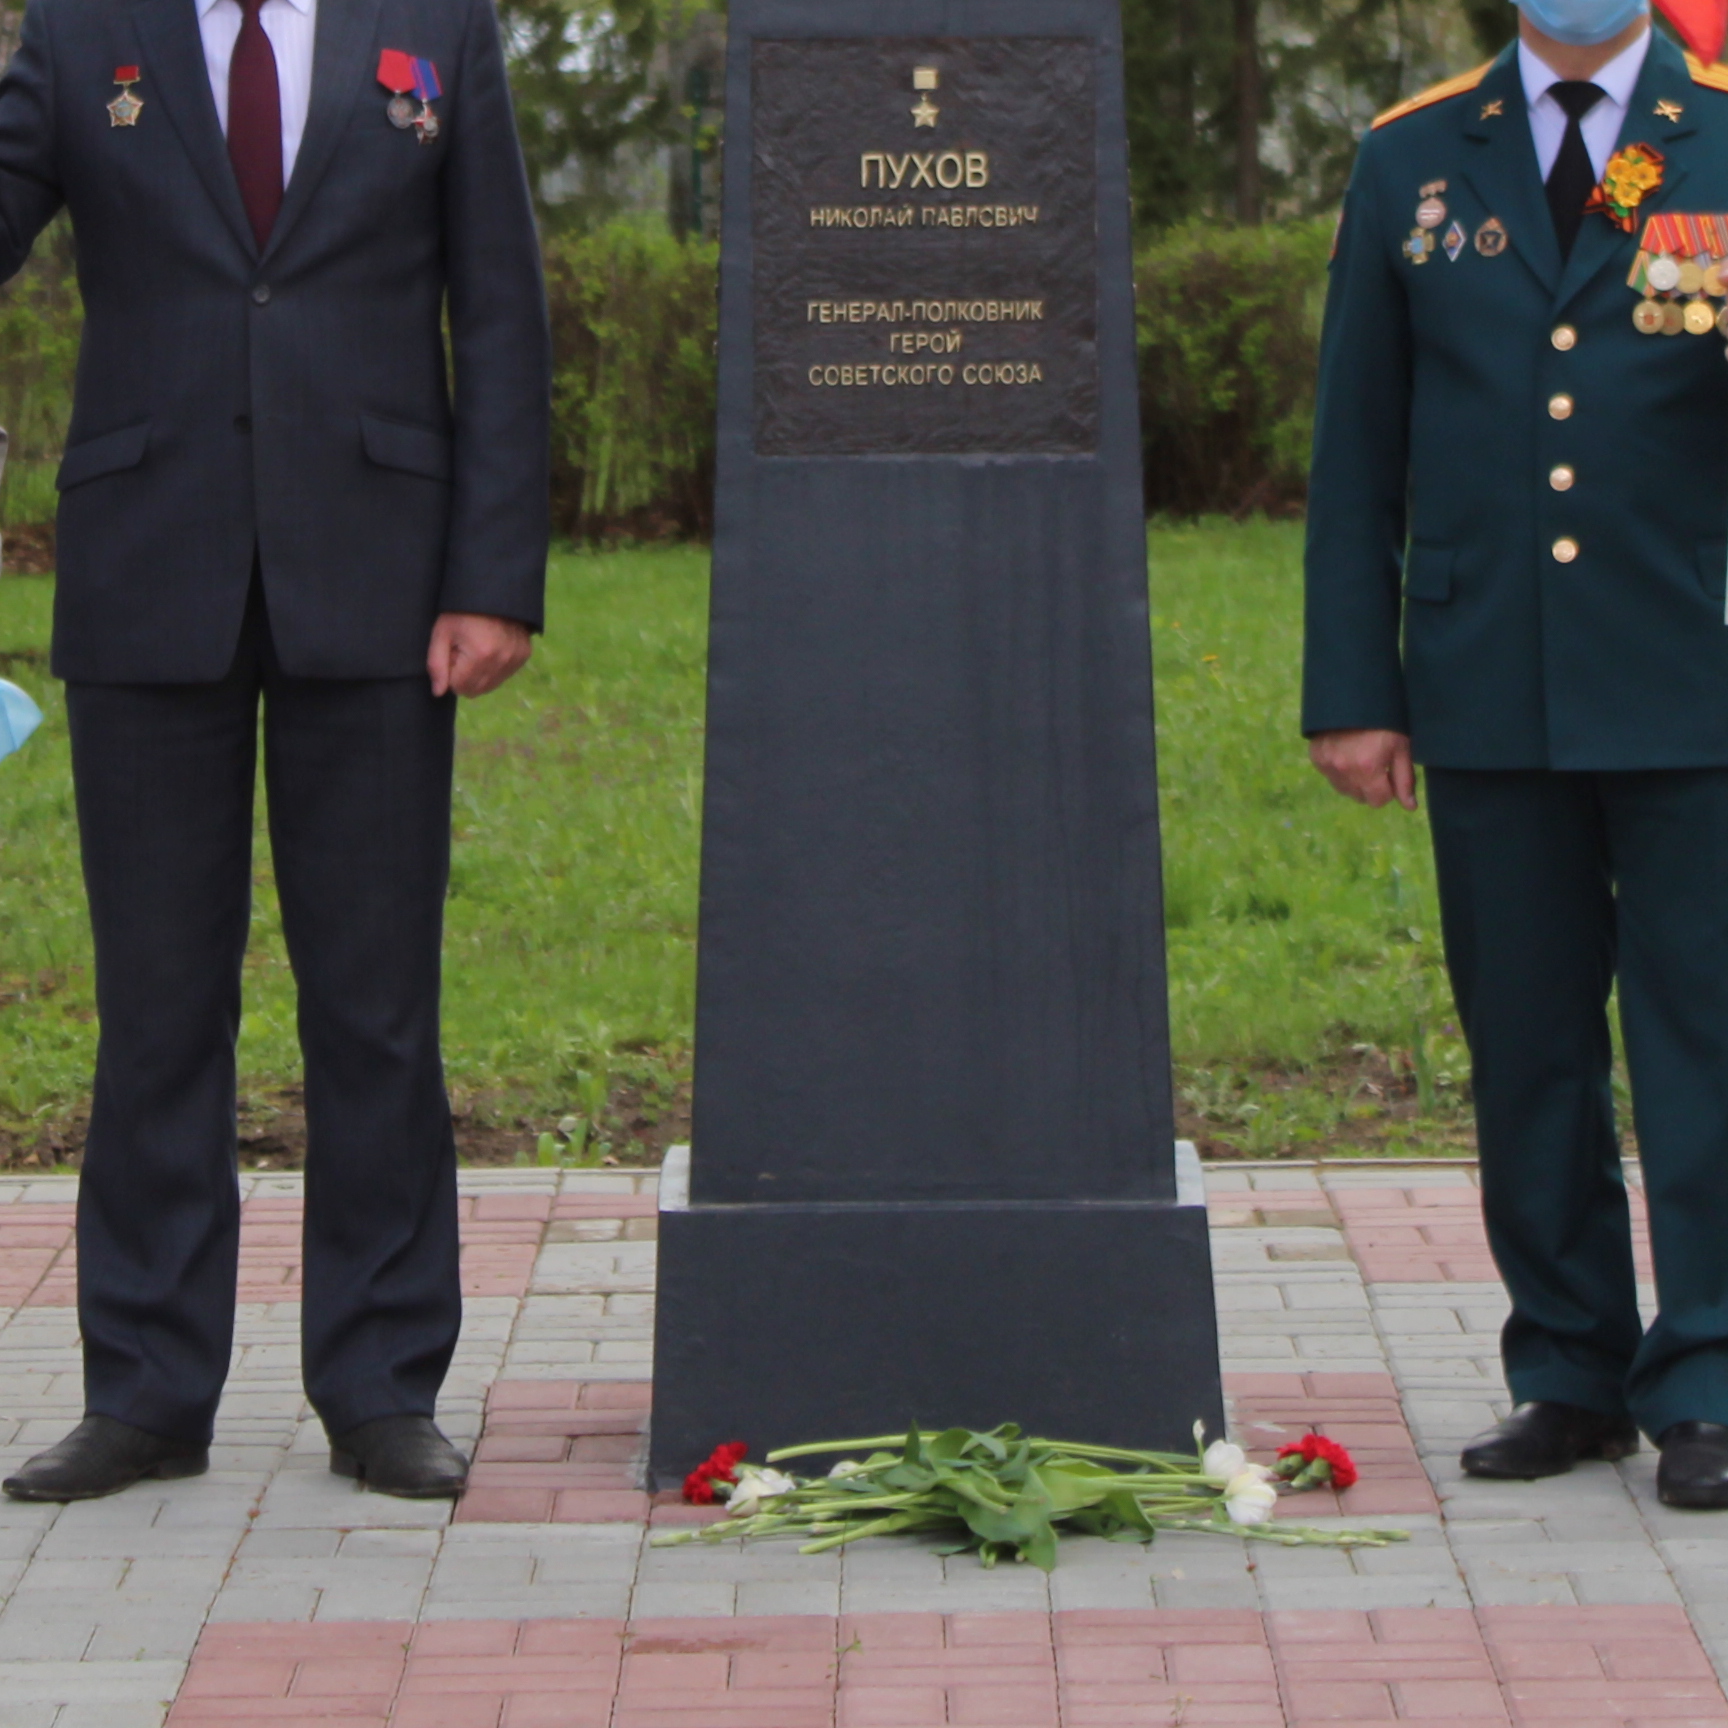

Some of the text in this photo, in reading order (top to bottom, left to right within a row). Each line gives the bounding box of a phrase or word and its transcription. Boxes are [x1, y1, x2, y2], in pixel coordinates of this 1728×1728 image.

[860, 151, 989, 189] ПУХОВ
[810, 204, 1039, 228] НИКОЛАЙ ПАВЛОВИЧ
[807, 300, 1044, 323] ГЕНЕРАЛ-ПОЛКОВНИК
[890, 327, 962, 354] ГЕРОЙ
[808, 362, 1043, 386] СОВЕТСКОГО СОЮЗА
